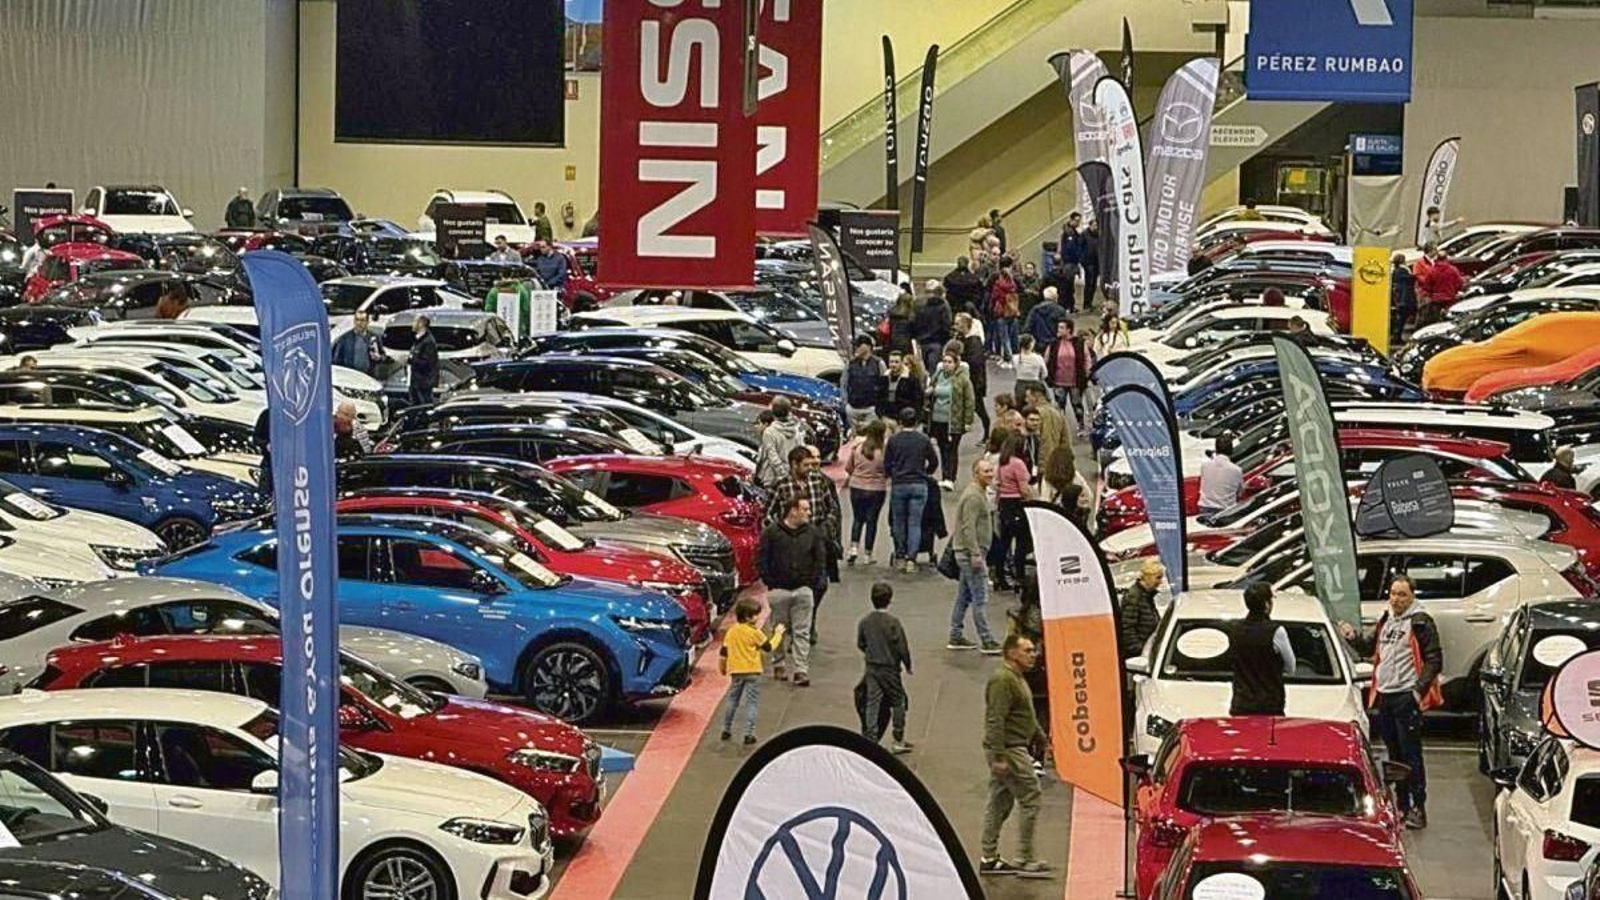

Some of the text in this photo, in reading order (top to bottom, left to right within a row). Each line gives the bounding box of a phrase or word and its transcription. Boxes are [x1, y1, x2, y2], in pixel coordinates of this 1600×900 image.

[1257, 52, 1404, 73] PÉREZ RUMBAO
[1212, 127, 1255, 135] ASCENSOR
[1151, 173, 1177, 273] URO MOTOR
[849, 227, 864, 235] Nos
[855, 238, 884, 246] conocer
